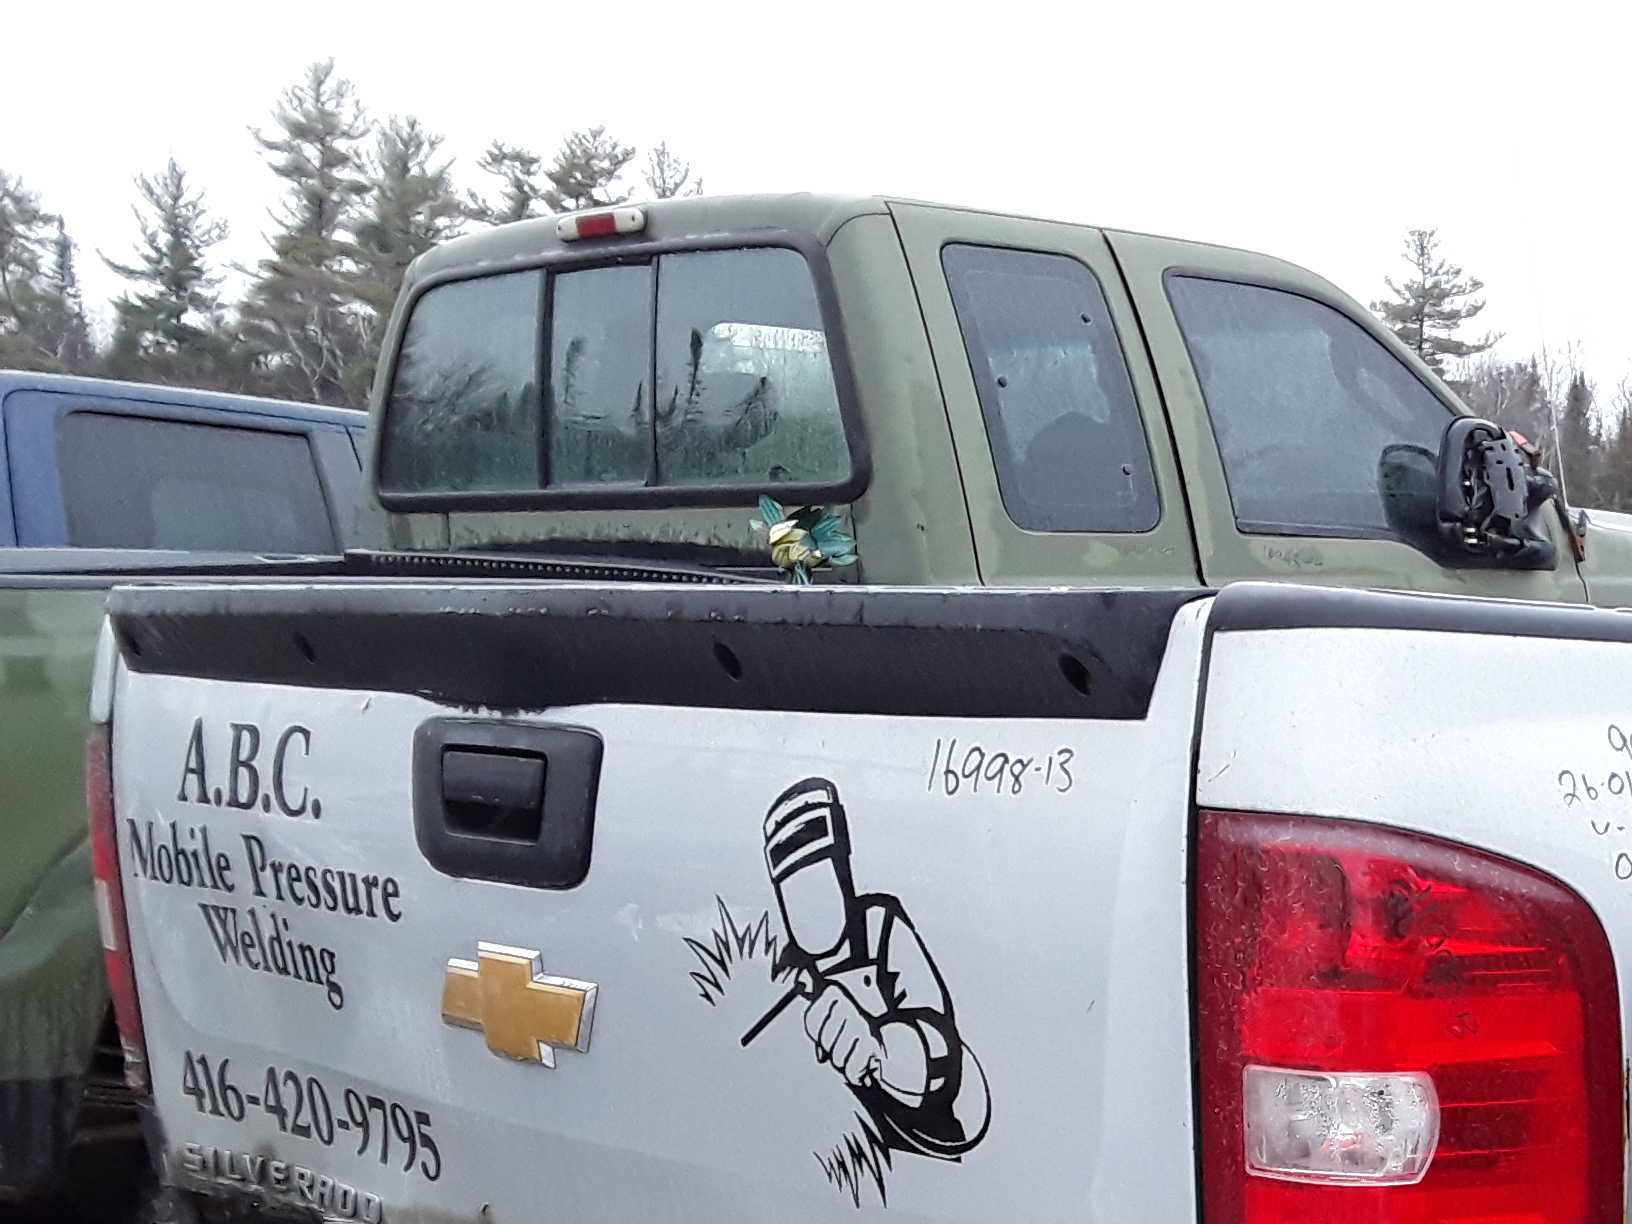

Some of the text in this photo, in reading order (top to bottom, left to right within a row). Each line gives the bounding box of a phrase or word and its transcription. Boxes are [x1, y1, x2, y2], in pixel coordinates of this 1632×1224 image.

[177, 716, 323, 820] A.B.C.
[926, 738, 1076, 794] 16998-13
[126, 817, 404, 923] Mobile Pressure
[199, 902, 345, 1010] Welding
[182, 1049, 442, 1183] 416-420-9795
